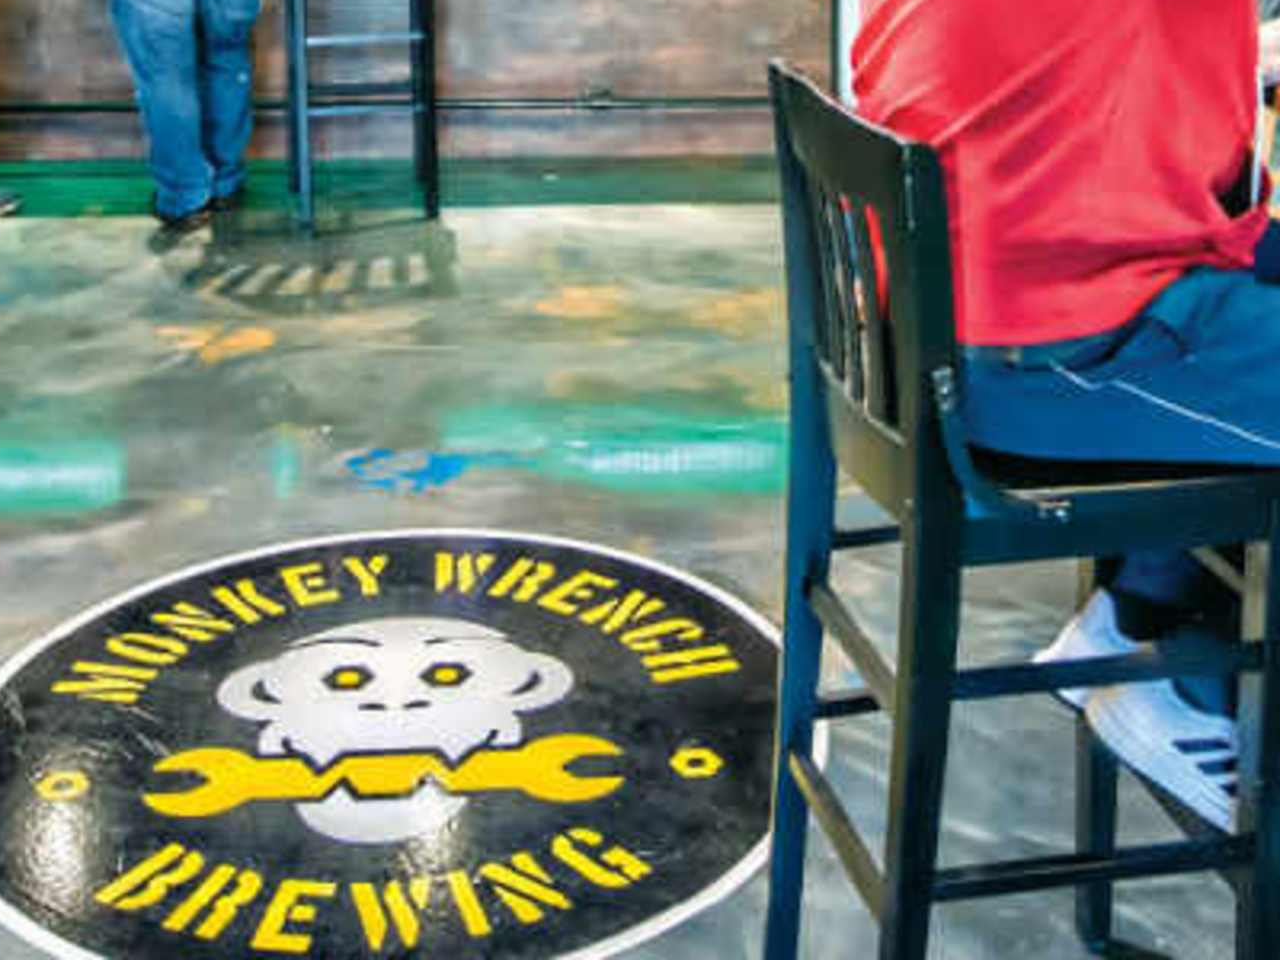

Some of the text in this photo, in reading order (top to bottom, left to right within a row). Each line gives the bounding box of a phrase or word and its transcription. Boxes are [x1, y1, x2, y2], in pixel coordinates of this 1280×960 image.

[48, 549, 742, 705] MONKEY WRENCH
[92, 826, 654, 954] BREWING
